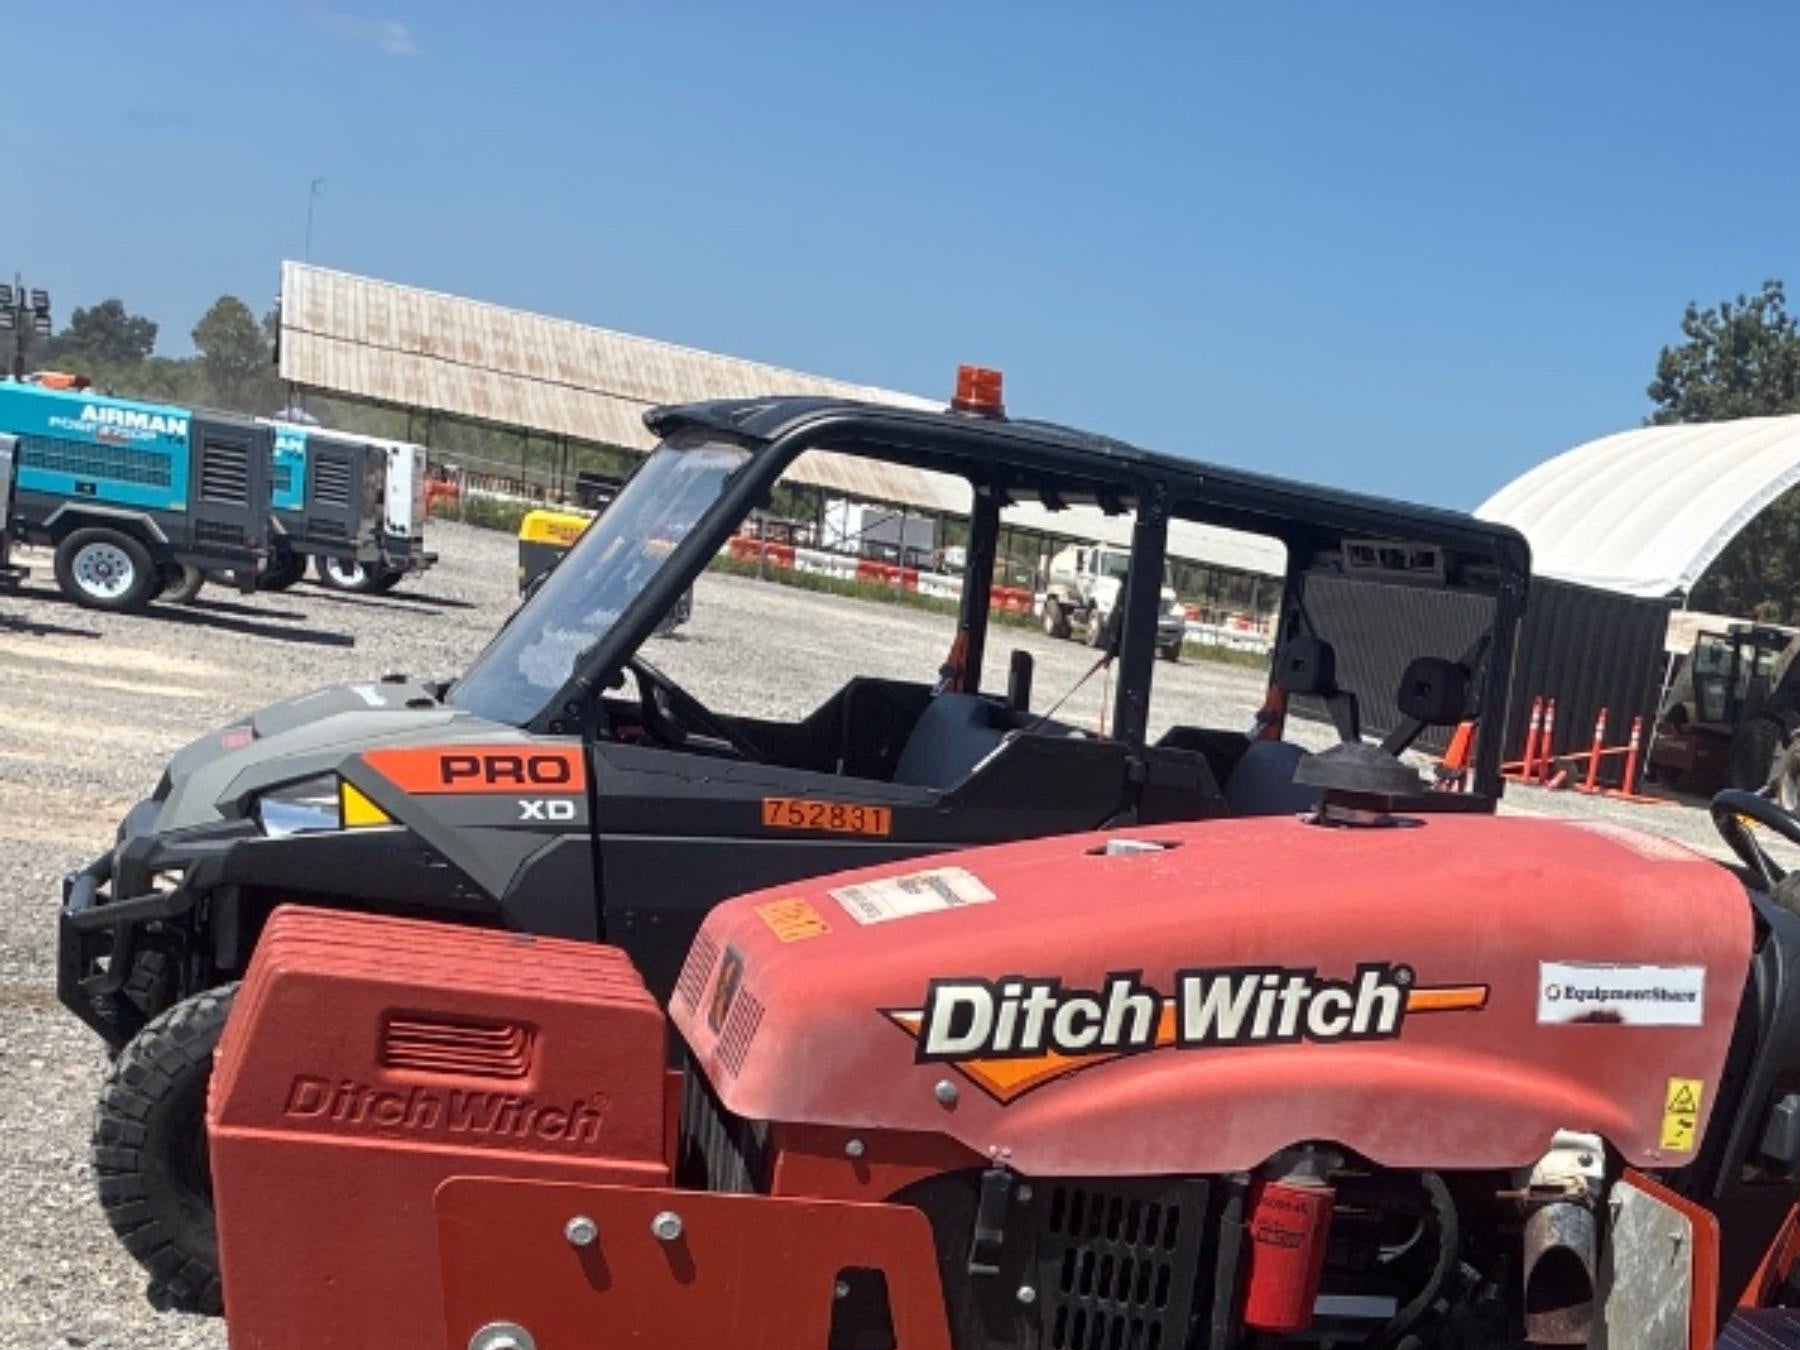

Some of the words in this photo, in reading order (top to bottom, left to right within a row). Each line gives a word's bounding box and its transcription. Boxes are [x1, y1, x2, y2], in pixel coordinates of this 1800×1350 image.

[81, 404, 187, 434] AIRMAN
[440, 755, 571, 785] PRO
[518, 800, 574, 820] XD
[768, 800, 886, 832] 752831
[1564, 986, 1697, 1002] EquipmentShare
[925, 980, 1147, 1054] Ditch
